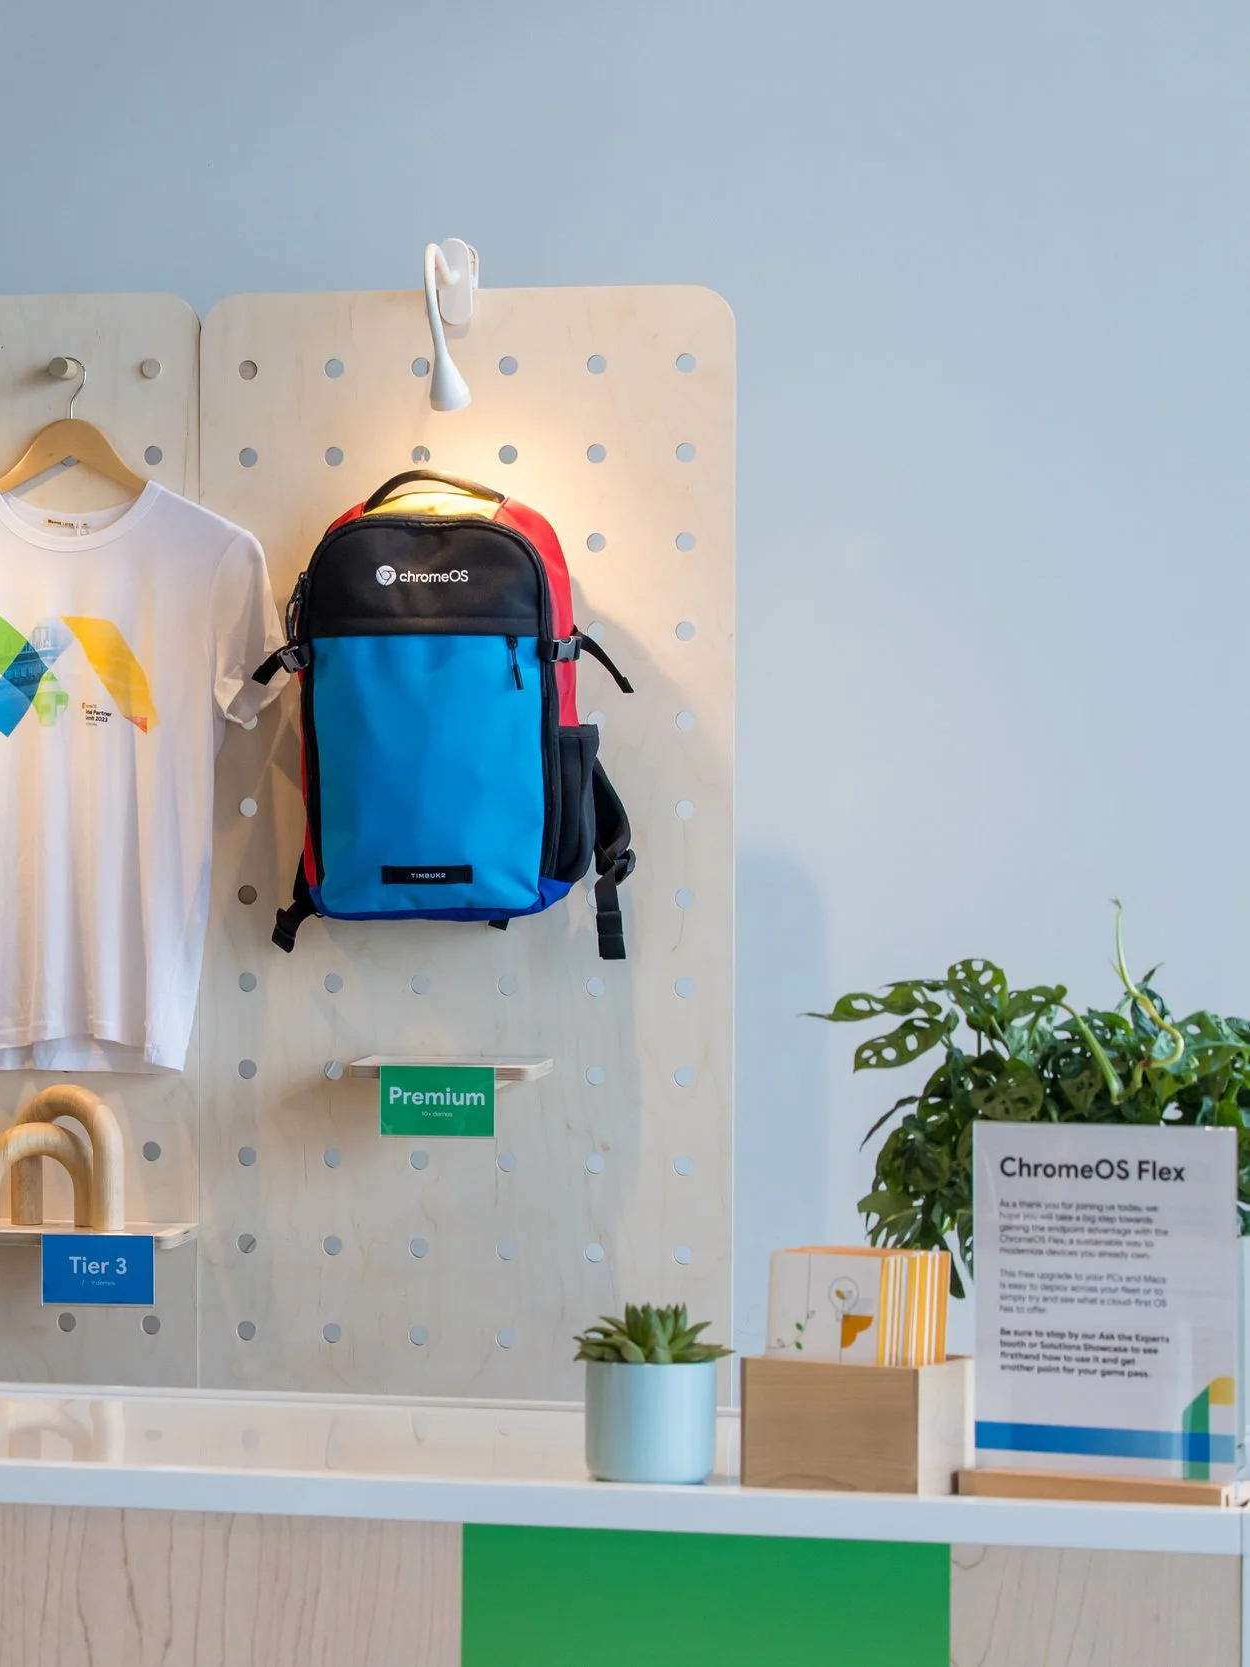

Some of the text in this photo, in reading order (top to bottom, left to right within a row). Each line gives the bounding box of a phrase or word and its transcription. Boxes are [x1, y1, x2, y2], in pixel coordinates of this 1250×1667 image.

[399, 569, 468, 583] chromeOS
[390, 1086, 486, 1106] Premium
[1000, 1157, 1184, 1181] ChromeOS Flex
[69, 1256, 127, 1275] Tier 3
